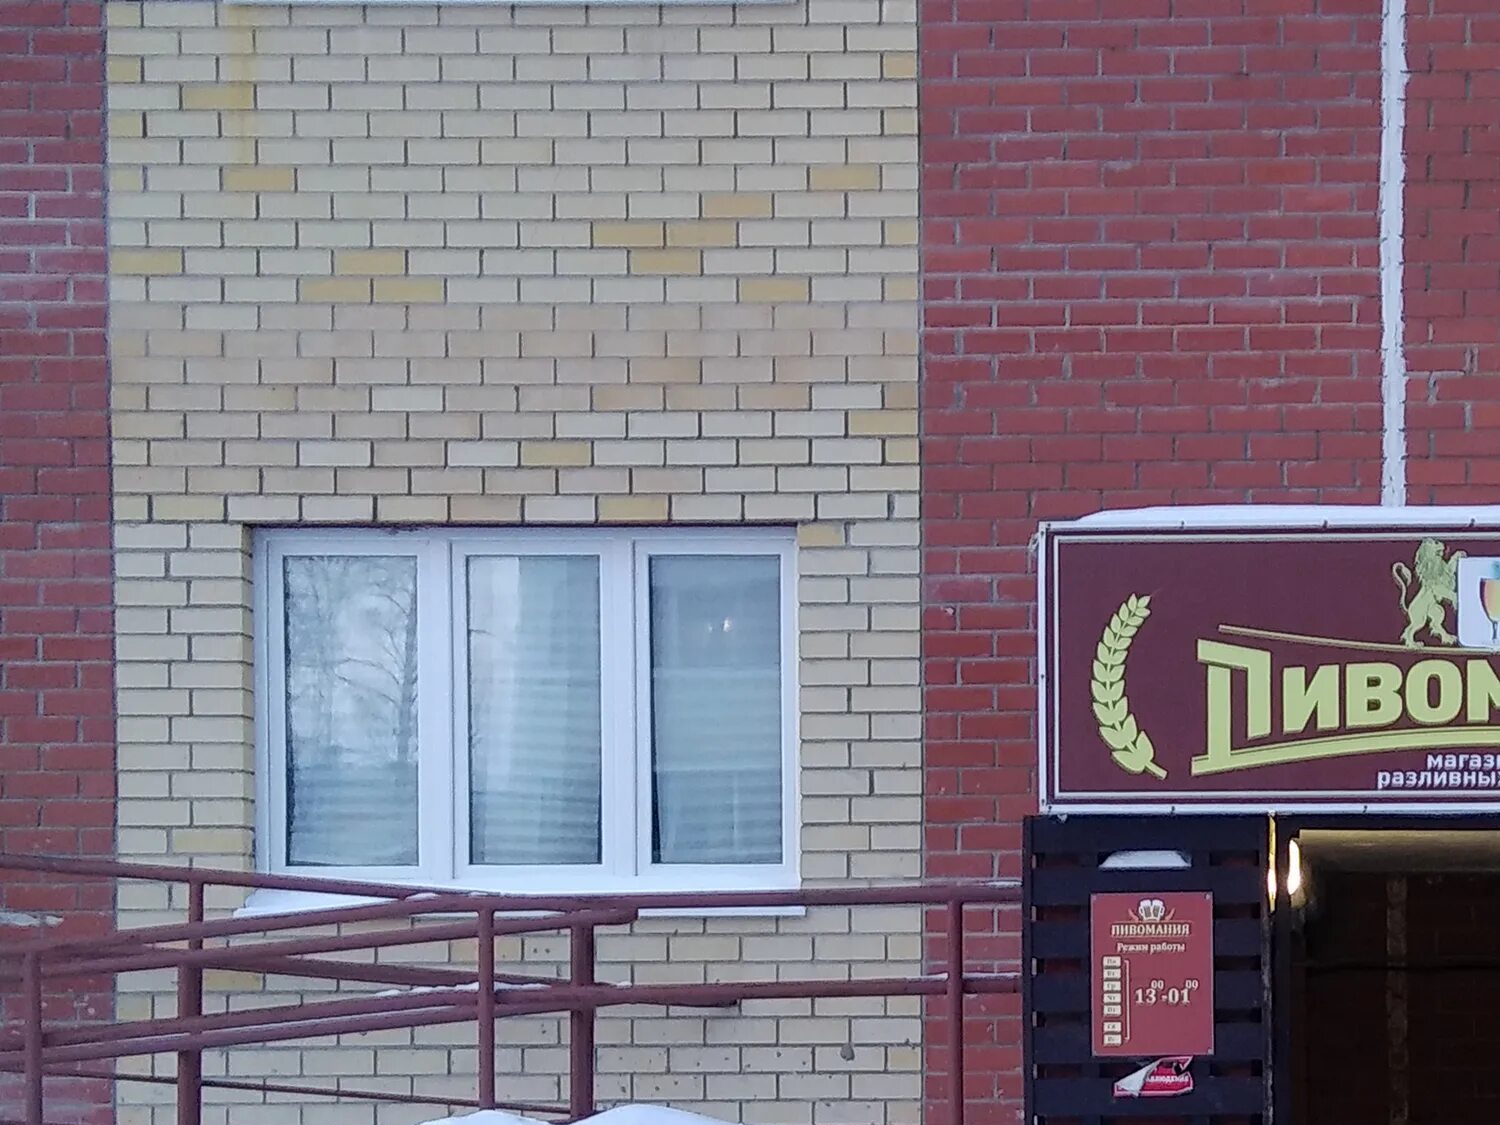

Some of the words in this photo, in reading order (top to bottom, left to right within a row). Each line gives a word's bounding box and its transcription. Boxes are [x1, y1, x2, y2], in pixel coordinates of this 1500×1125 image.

[1111, 923, 1190, 936] ПИВОМАНИЯ
[1117, 942, 1149, 952] Режим
[1150, 941, 1186, 954] работы
